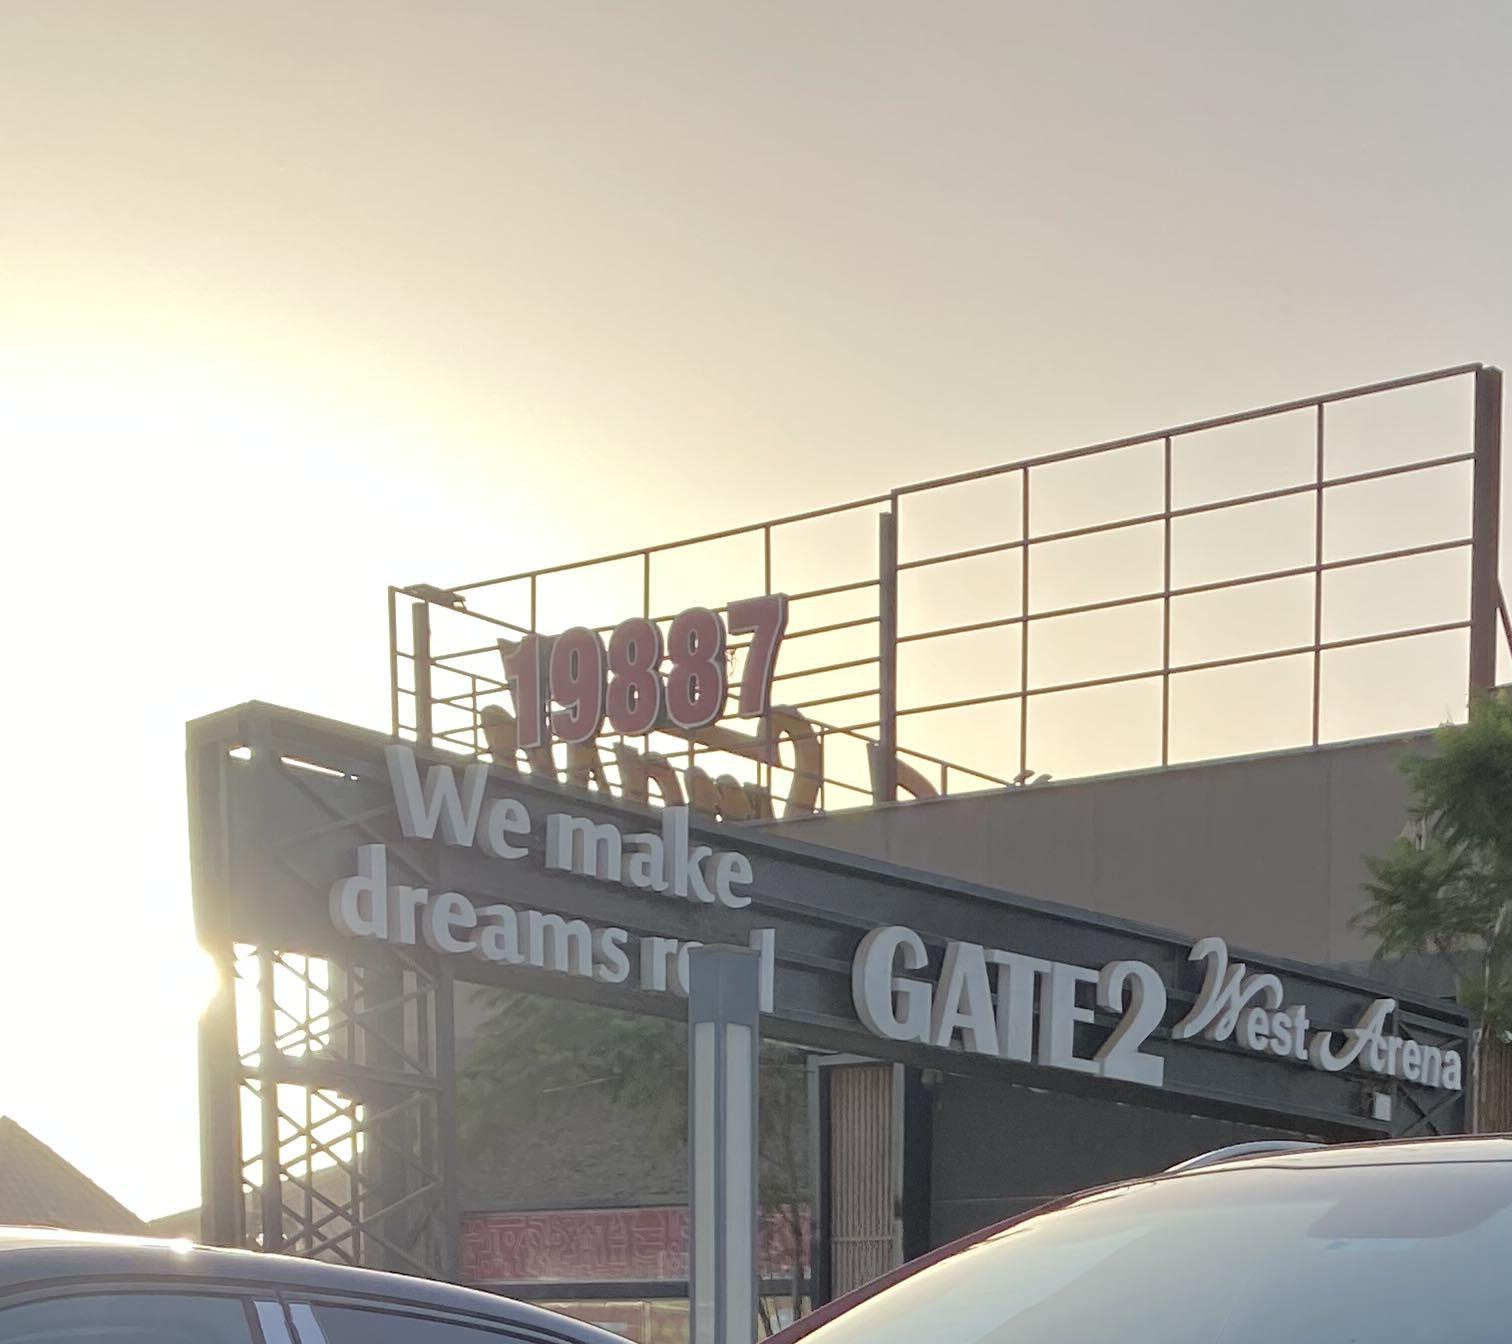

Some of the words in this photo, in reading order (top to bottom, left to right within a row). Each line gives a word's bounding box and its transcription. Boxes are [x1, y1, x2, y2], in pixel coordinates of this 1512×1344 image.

[497, 593, 789, 748] 19887
[386, 745, 532, 860] We
[545, 805, 755, 909] make
[330, 843, 629, 984] dreams
[640, 928, 776, 1014] rl
[1172, 936, 1308, 1061] West
[1309, 997, 1462, 1092] Arena
